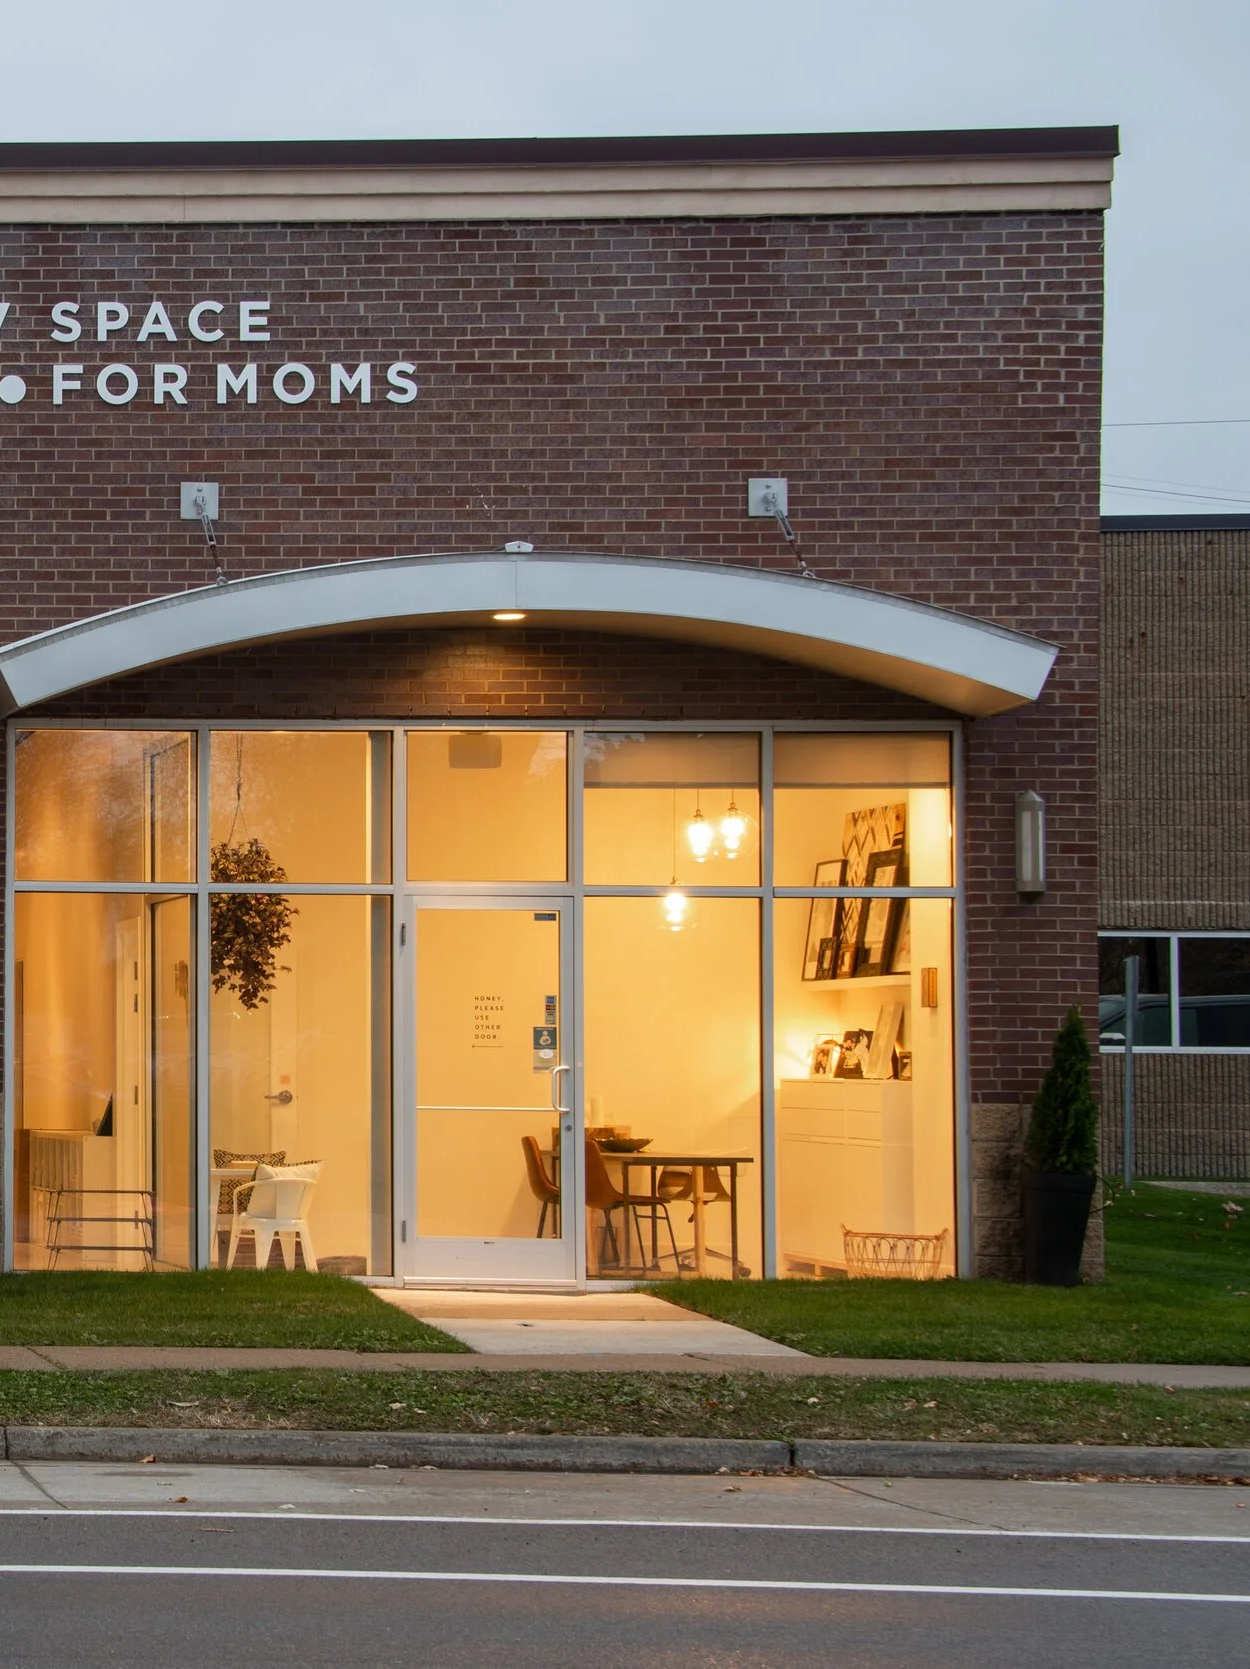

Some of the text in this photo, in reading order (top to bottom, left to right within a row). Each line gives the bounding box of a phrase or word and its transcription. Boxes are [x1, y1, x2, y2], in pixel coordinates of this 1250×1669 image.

[50, 301, 271, 343] SPACE
[52, 362, 418, 405] FOR MOMS
